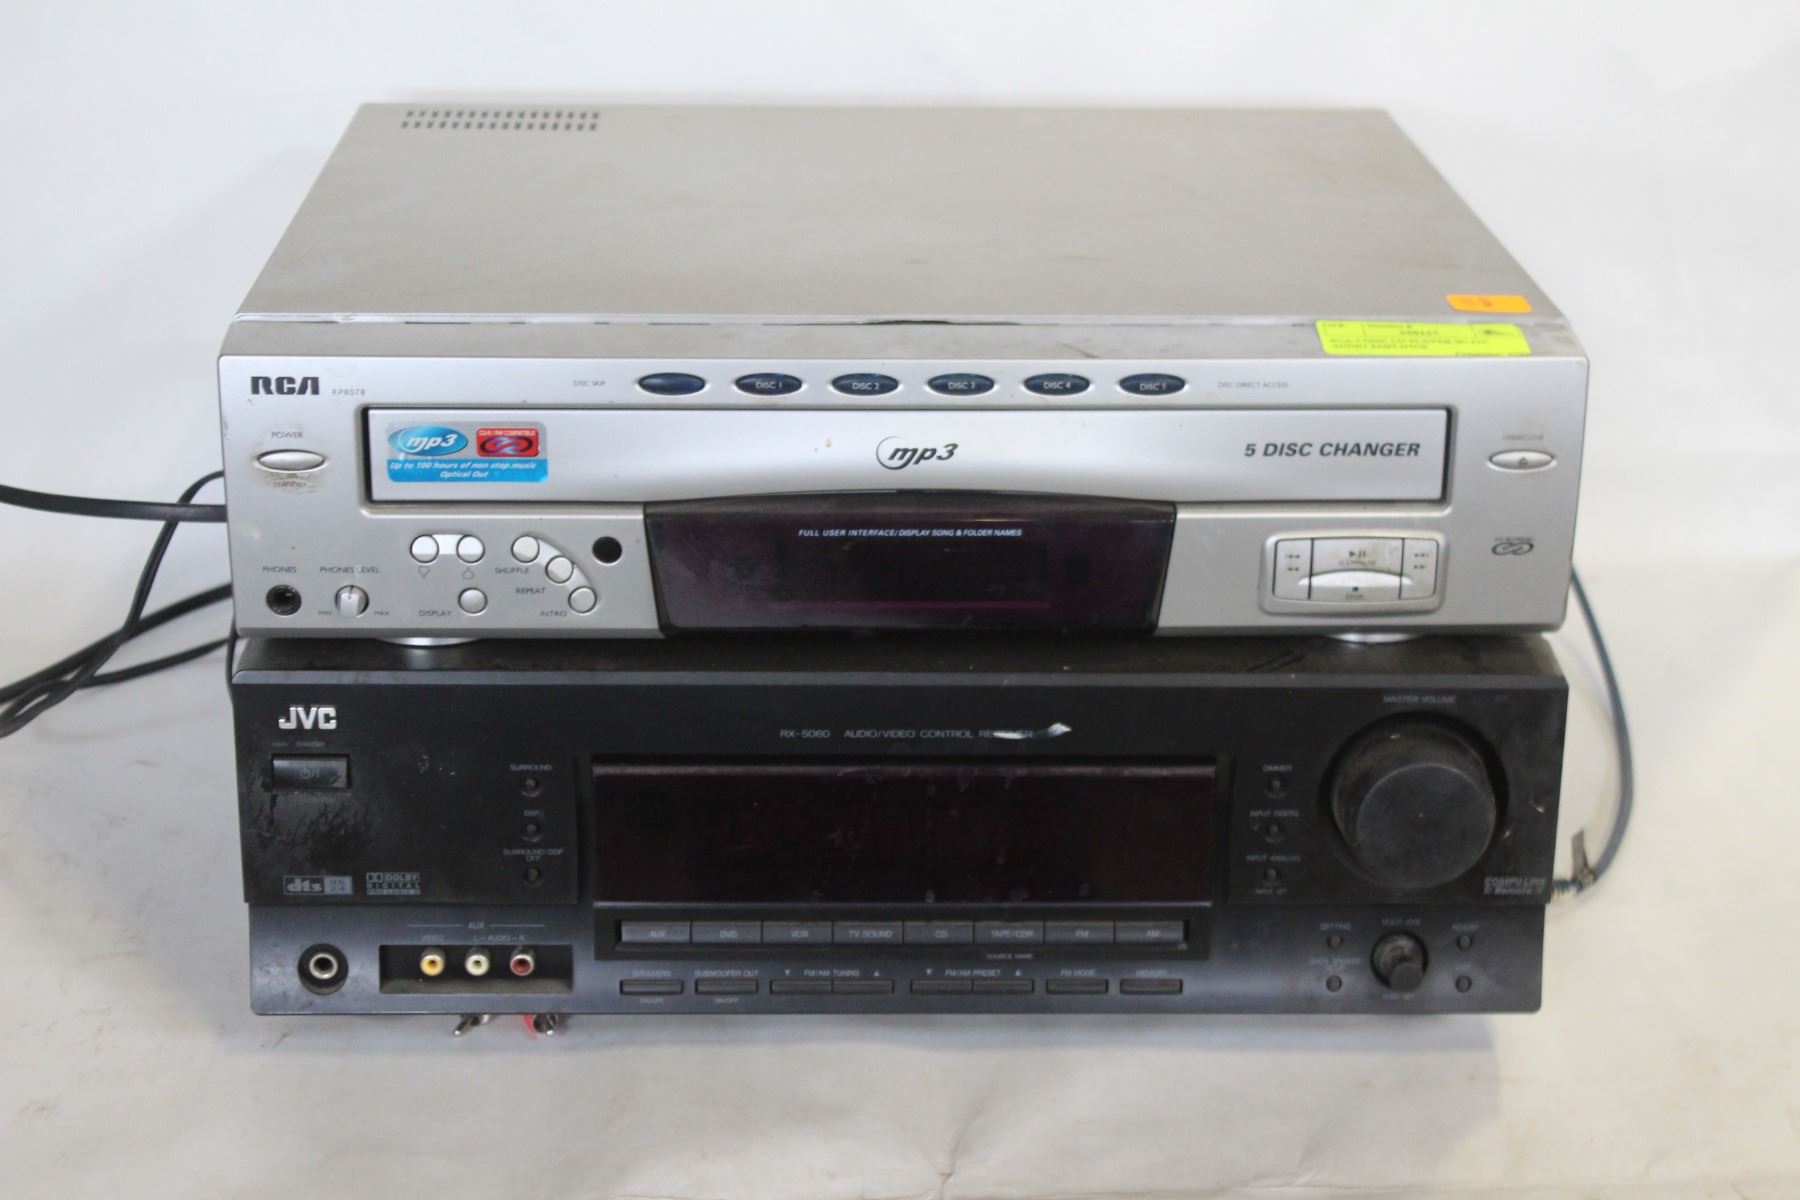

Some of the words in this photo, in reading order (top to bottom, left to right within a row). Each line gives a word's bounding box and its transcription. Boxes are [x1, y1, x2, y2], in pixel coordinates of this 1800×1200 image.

[250, 376, 320, 395] RCA
[755, 381, 777, 390] DISC
[851, 382, 873, 391] DISC
[874, 382, 880, 391] 2
[947, 381, 969, 390] DISC
[1043, 381, 1064, 390] DISC
[1064, 381, 1071, 390] 4
[1139, 383, 1160, 392] DISC
[271, 430, 304, 439] POWER
[403, 433, 459, 453] mp3
[876, 436, 959, 470] mp3
[1244, 443, 1257, 457] 5
[1262, 443, 1313, 457] DISC
[1318, 442, 1421, 458] CHANGER
[390, 461, 402, 470] Up
[416, 461, 431, 469] 100
[459, 461, 471, 469] of
[511, 462, 537, 470] music
[439, 470, 470, 479] Optical
[471, 470, 489, 478] Out
[798, 528, 820, 538] FULL
[822, 528, 846, 538] USER
[931, 528, 954, 538] SONG
[955, 528, 962, 538] &
[962, 528, 993, 538] FOLDER
[993, 528, 1023, 538] NAMES
[262, 565, 297, 575] PHONES
[319, 565, 354, 575] PHONES
[494, 567, 530, 576] SHUFFLE
[515, 586, 546, 595] REPEAT
[418, 609, 452, 618] DISPLAY
[539, 609, 568, 618] INTRO
[278, 706, 337, 730] JVC
[779, 729, 831, 739] RX-5060
[844, 729, 916, 739] AUDIO/VIDEO
[919, 729, 973, 739] CONTROL
[385, 874, 418, 882] DOLBY
[287, 878, 322, 892] dts
[468, 922, 485, 930] AUX
[719, 929, 738, 938] DVD
[791, 929, 809, 938] VCR
[849, 929, 861, 938] TV
[863, 929, 894, 938] SOUND
[934, 929, 948, 938] CD
[991, 929, 1034, 938] TAPE/CDR
[1075, 929, 1089, 938] FM
[1146, 929, 1160, 938] AM
[420, 934, 445, 943] VIDEO
[742, 969, 759, 978] OUT
[833, 969, 860, 977] TUNING
[972, 968, 1001, 977] PRESET
[1060, 968, 1073, 977] FM
[1074, 968, 1096, 977] MODE
